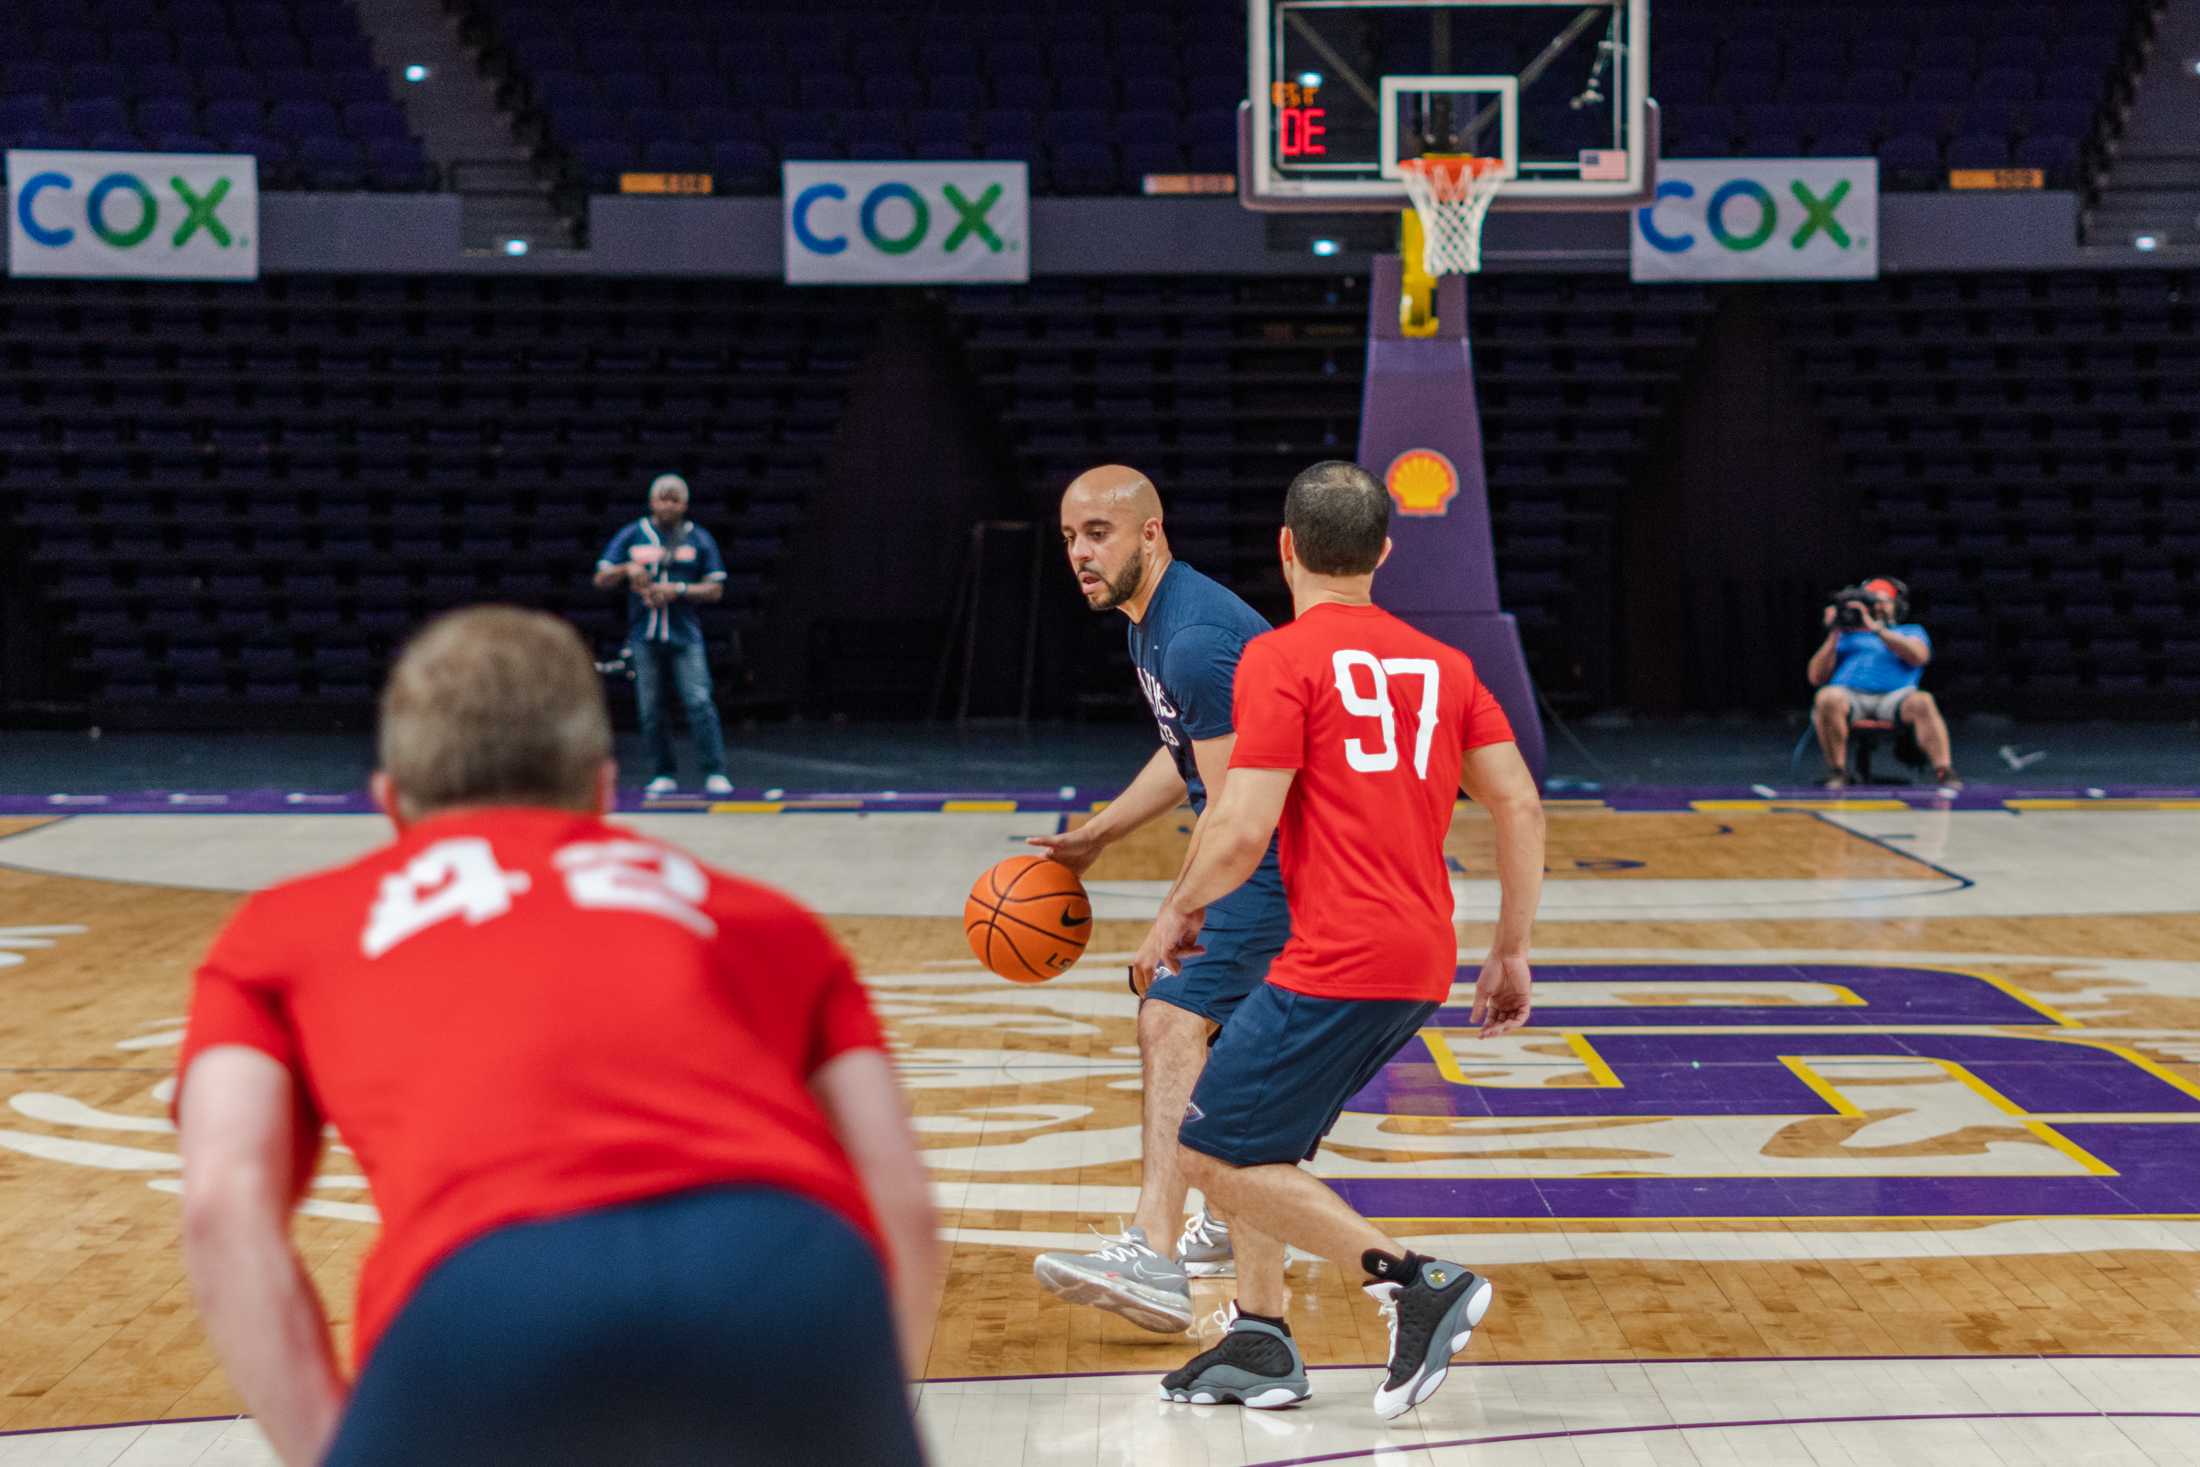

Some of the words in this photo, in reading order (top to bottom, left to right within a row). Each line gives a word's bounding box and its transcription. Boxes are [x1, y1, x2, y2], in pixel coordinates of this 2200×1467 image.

[17, 171, 233, 248] COX
[792, 182, 1004, 255] COX
[1638, 178, 1851, 253] COX
[1332, 649, 1439, 779] 97
[362, 836, 717, 958] 42
